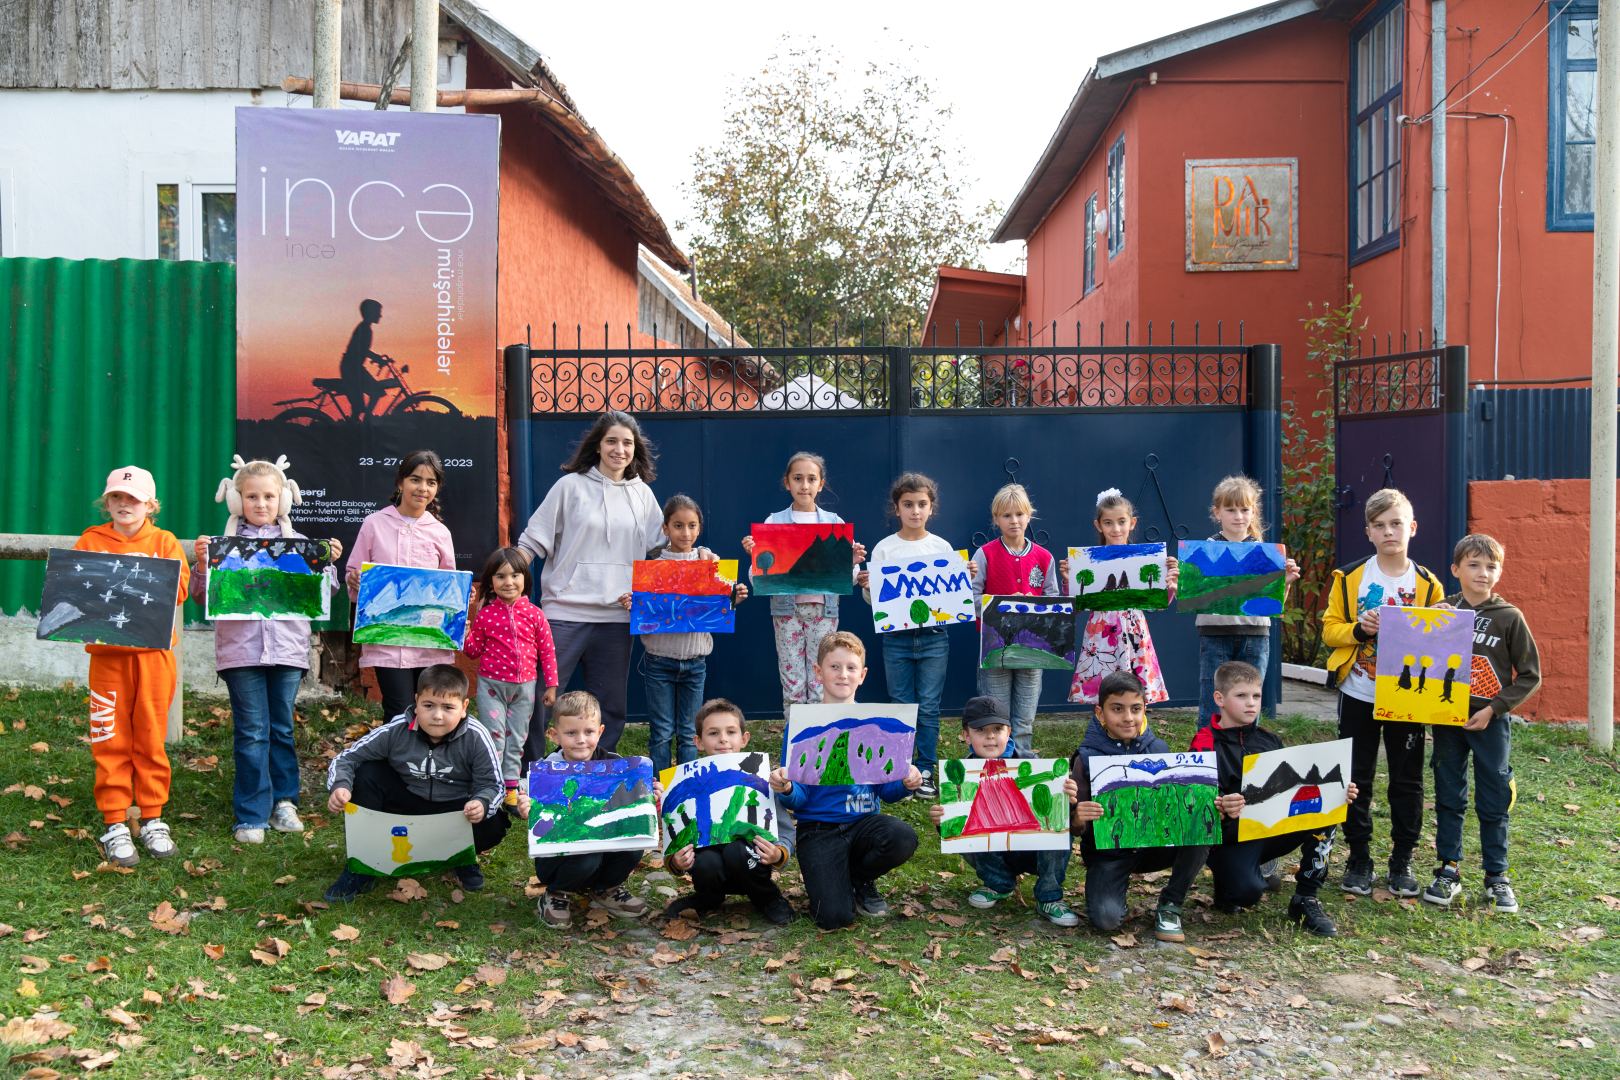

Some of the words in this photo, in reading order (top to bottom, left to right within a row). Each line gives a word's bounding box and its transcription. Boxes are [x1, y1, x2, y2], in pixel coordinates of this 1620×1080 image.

[335, 130, 401, 147] YARAT
[260, 166, 474, 244] incə
[285, 240, 336, 259] incə
[433, 248, 455, 375] müşahidələr
[359, 458, 374, 466] 23
[383, 458, 398, 466] 27
[444, 459, 473, 467] 2023
[341, 500, 377, 508] Babayev
[1485, 635, 1501, 648] IT
